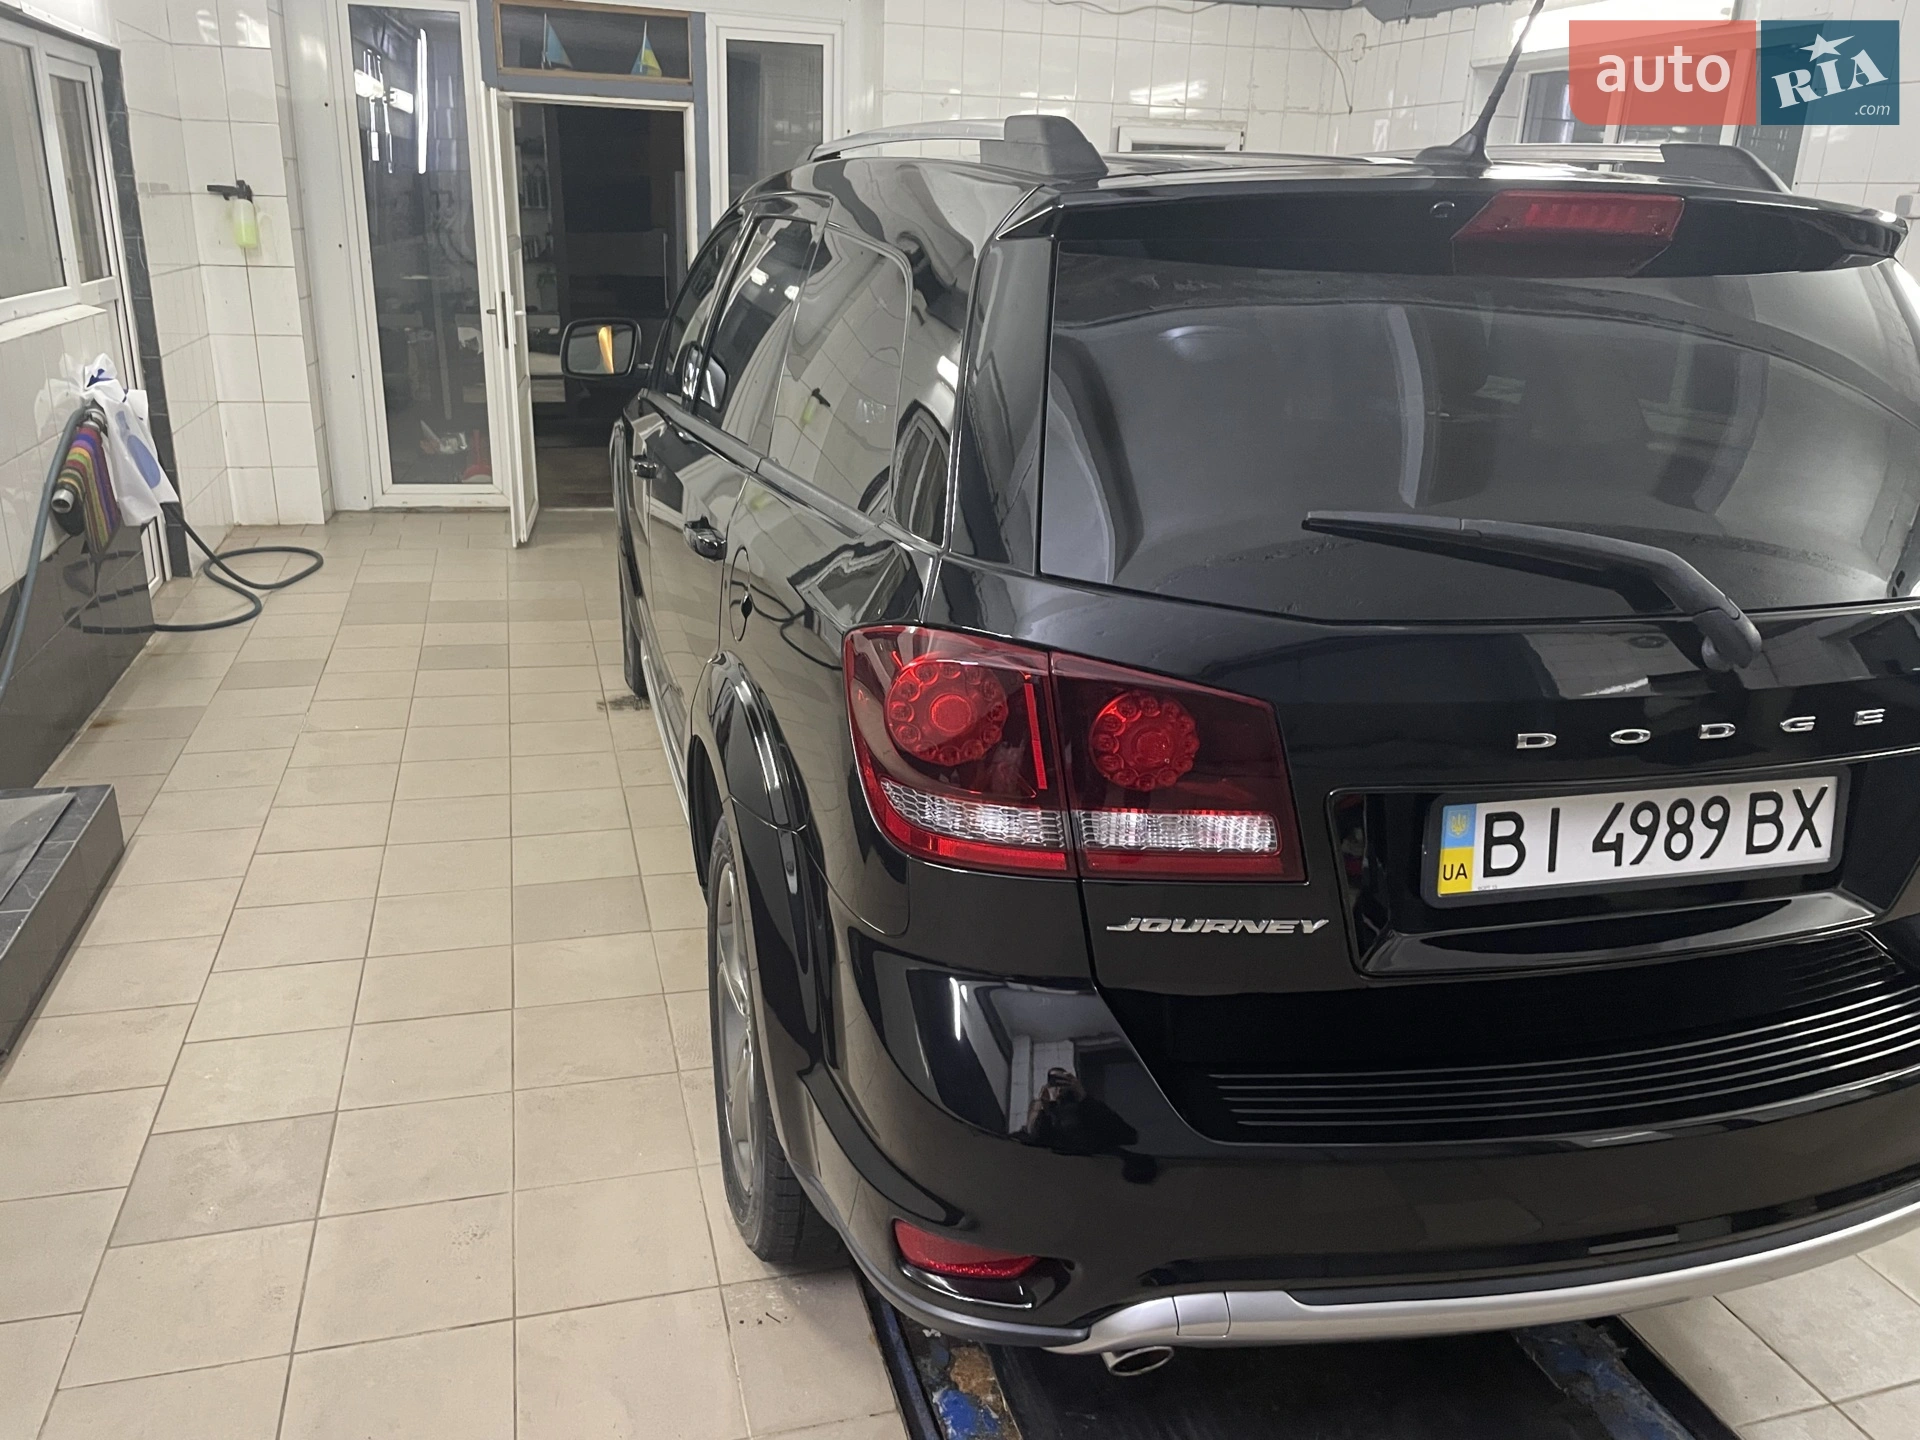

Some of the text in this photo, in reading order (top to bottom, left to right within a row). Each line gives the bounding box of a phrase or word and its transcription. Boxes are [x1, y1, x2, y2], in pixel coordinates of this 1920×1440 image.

[1516, 708, 1886, 749] DODGE
[1482, 786, 1829, 878] BI 4989 BX
[1442, 863, 1468, 881] UA
[1106, 917, 1329, 934] JOURNEY
